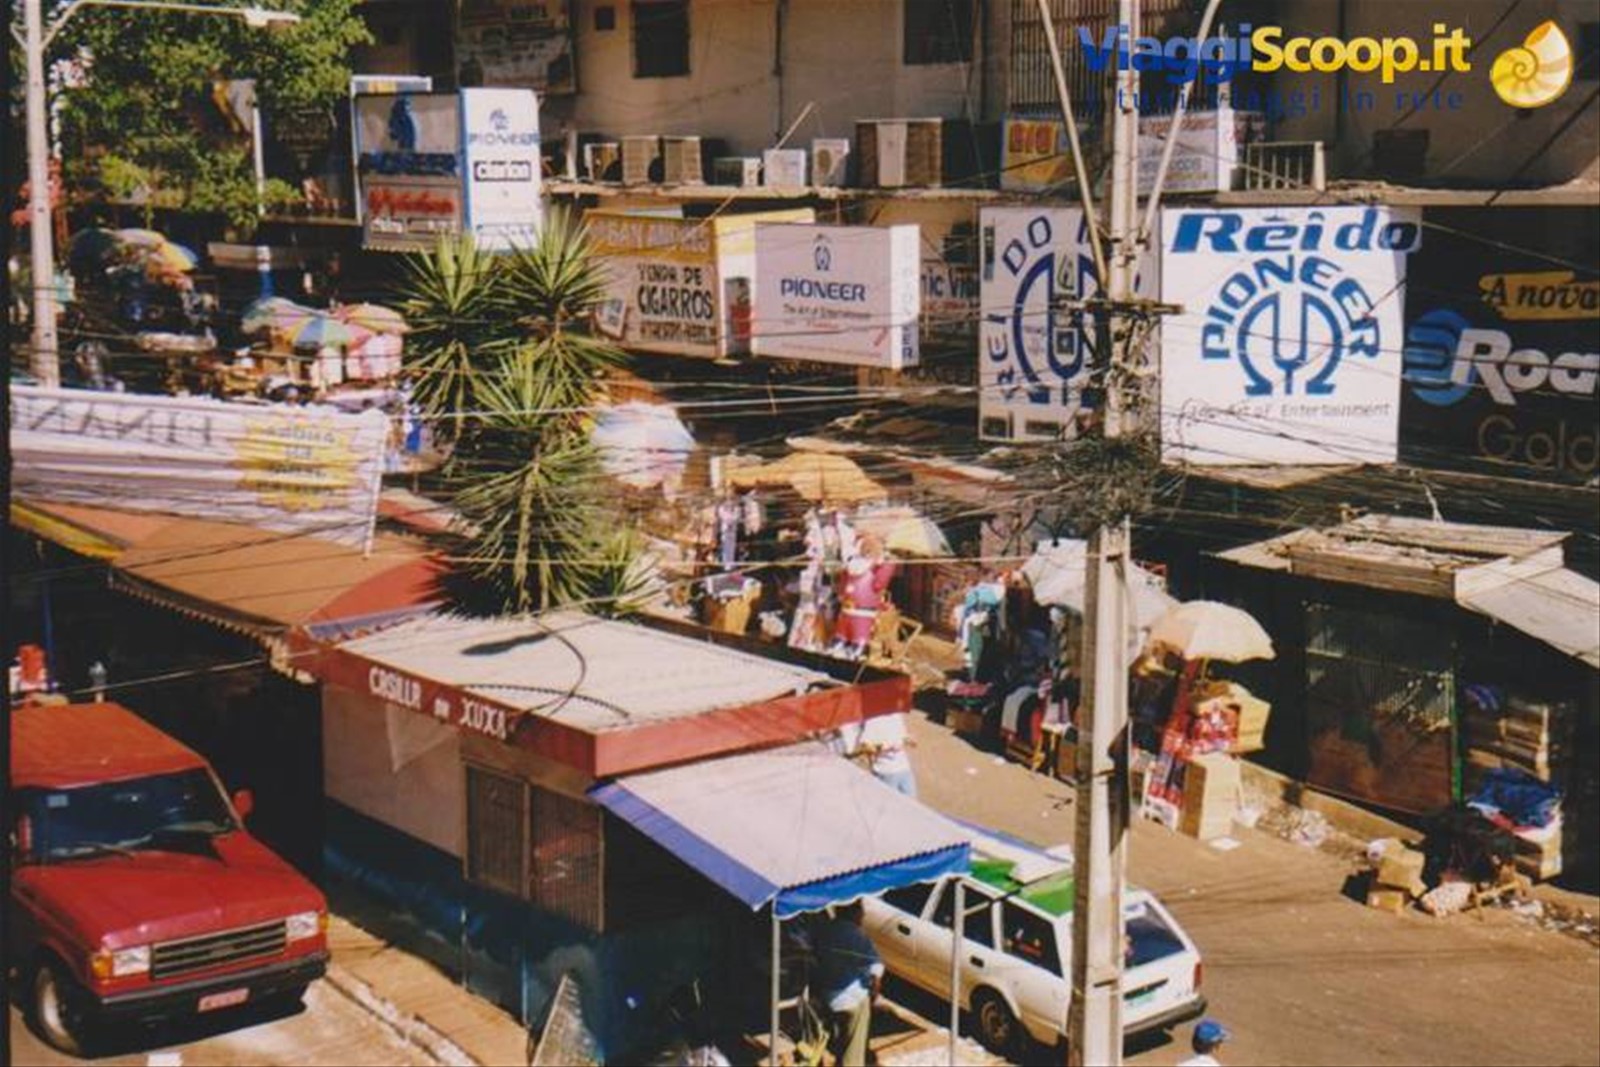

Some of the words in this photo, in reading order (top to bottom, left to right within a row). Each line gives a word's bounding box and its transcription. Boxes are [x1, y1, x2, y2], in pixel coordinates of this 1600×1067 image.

[637, 285, 714, 320] CIGARROS
[780, 277, 867, 302] PIONEER
[1201, 253, 1381, 360] PIONEER
[1517, 281, 1600, 311] nova
[458, 697, 508, 740] XUXA
